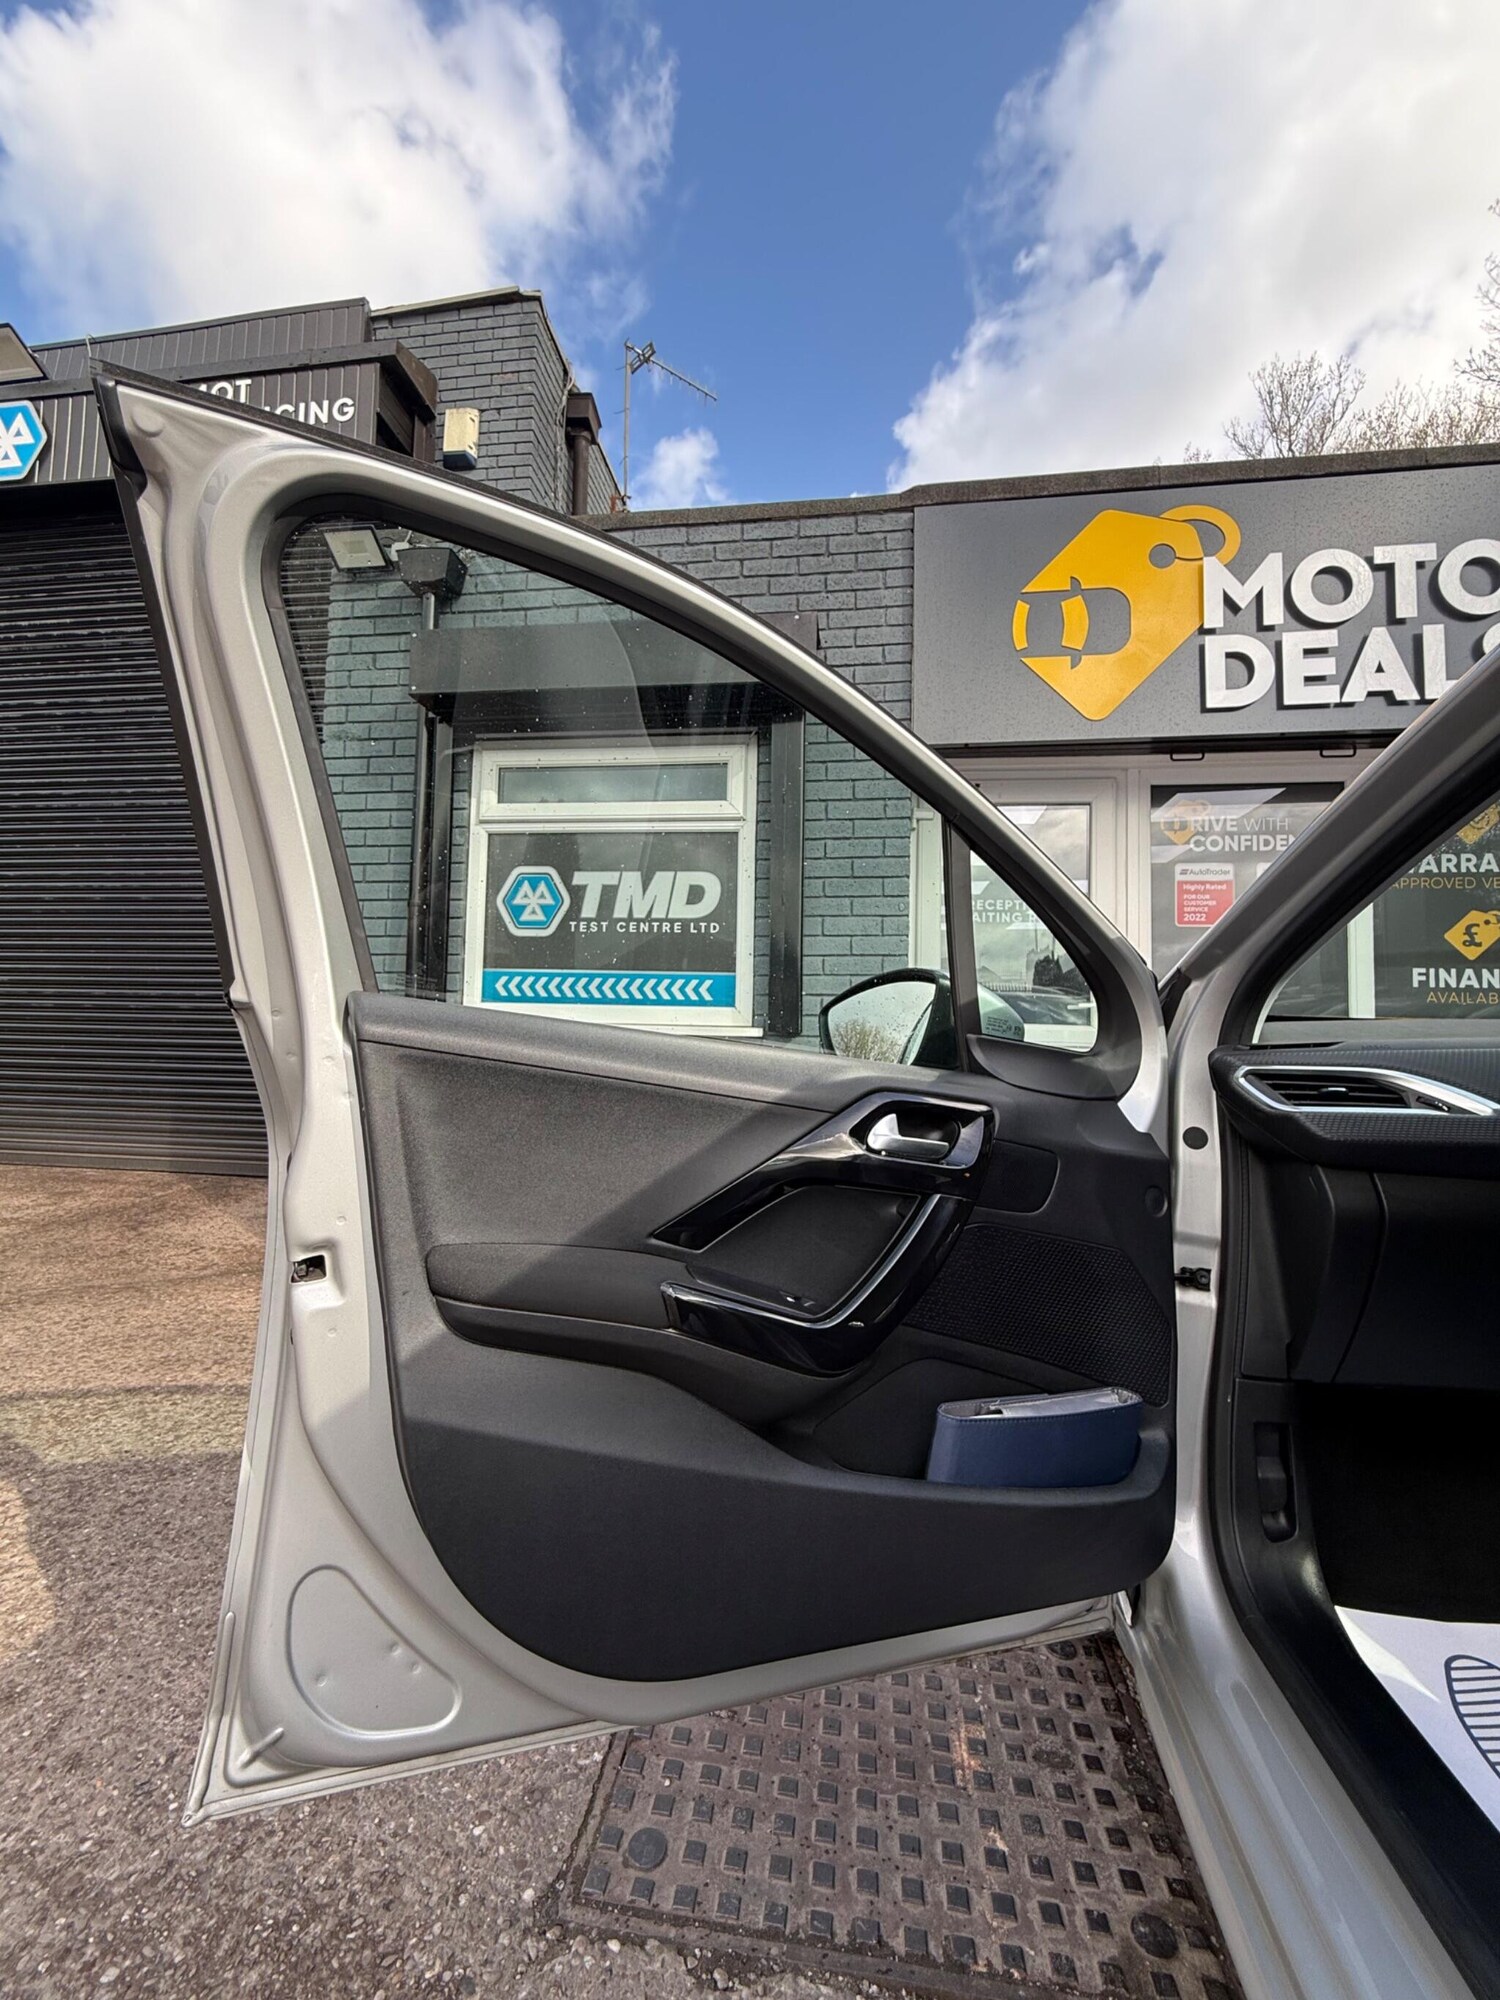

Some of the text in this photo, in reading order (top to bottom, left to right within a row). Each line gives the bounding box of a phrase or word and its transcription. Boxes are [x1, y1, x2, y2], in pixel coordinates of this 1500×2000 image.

[199, 379, 252, 404] OT
[1203, 537, 1500, 629] MOTO
[1204, 622, 1500, 709] DEAL
[1243, 817, 1288, 831] WITH
[1408, 853, 1500, 873] ARRA
[571, 871, 722, 918] TMD
[973, 900, 1027, 910] ECEPTI
[569, 921, 720, 933] TEST CENTRE LTD
[1412, 968, 1500, 989] FINAN
[1426, 991, 1499, 1005] AVAILAB
